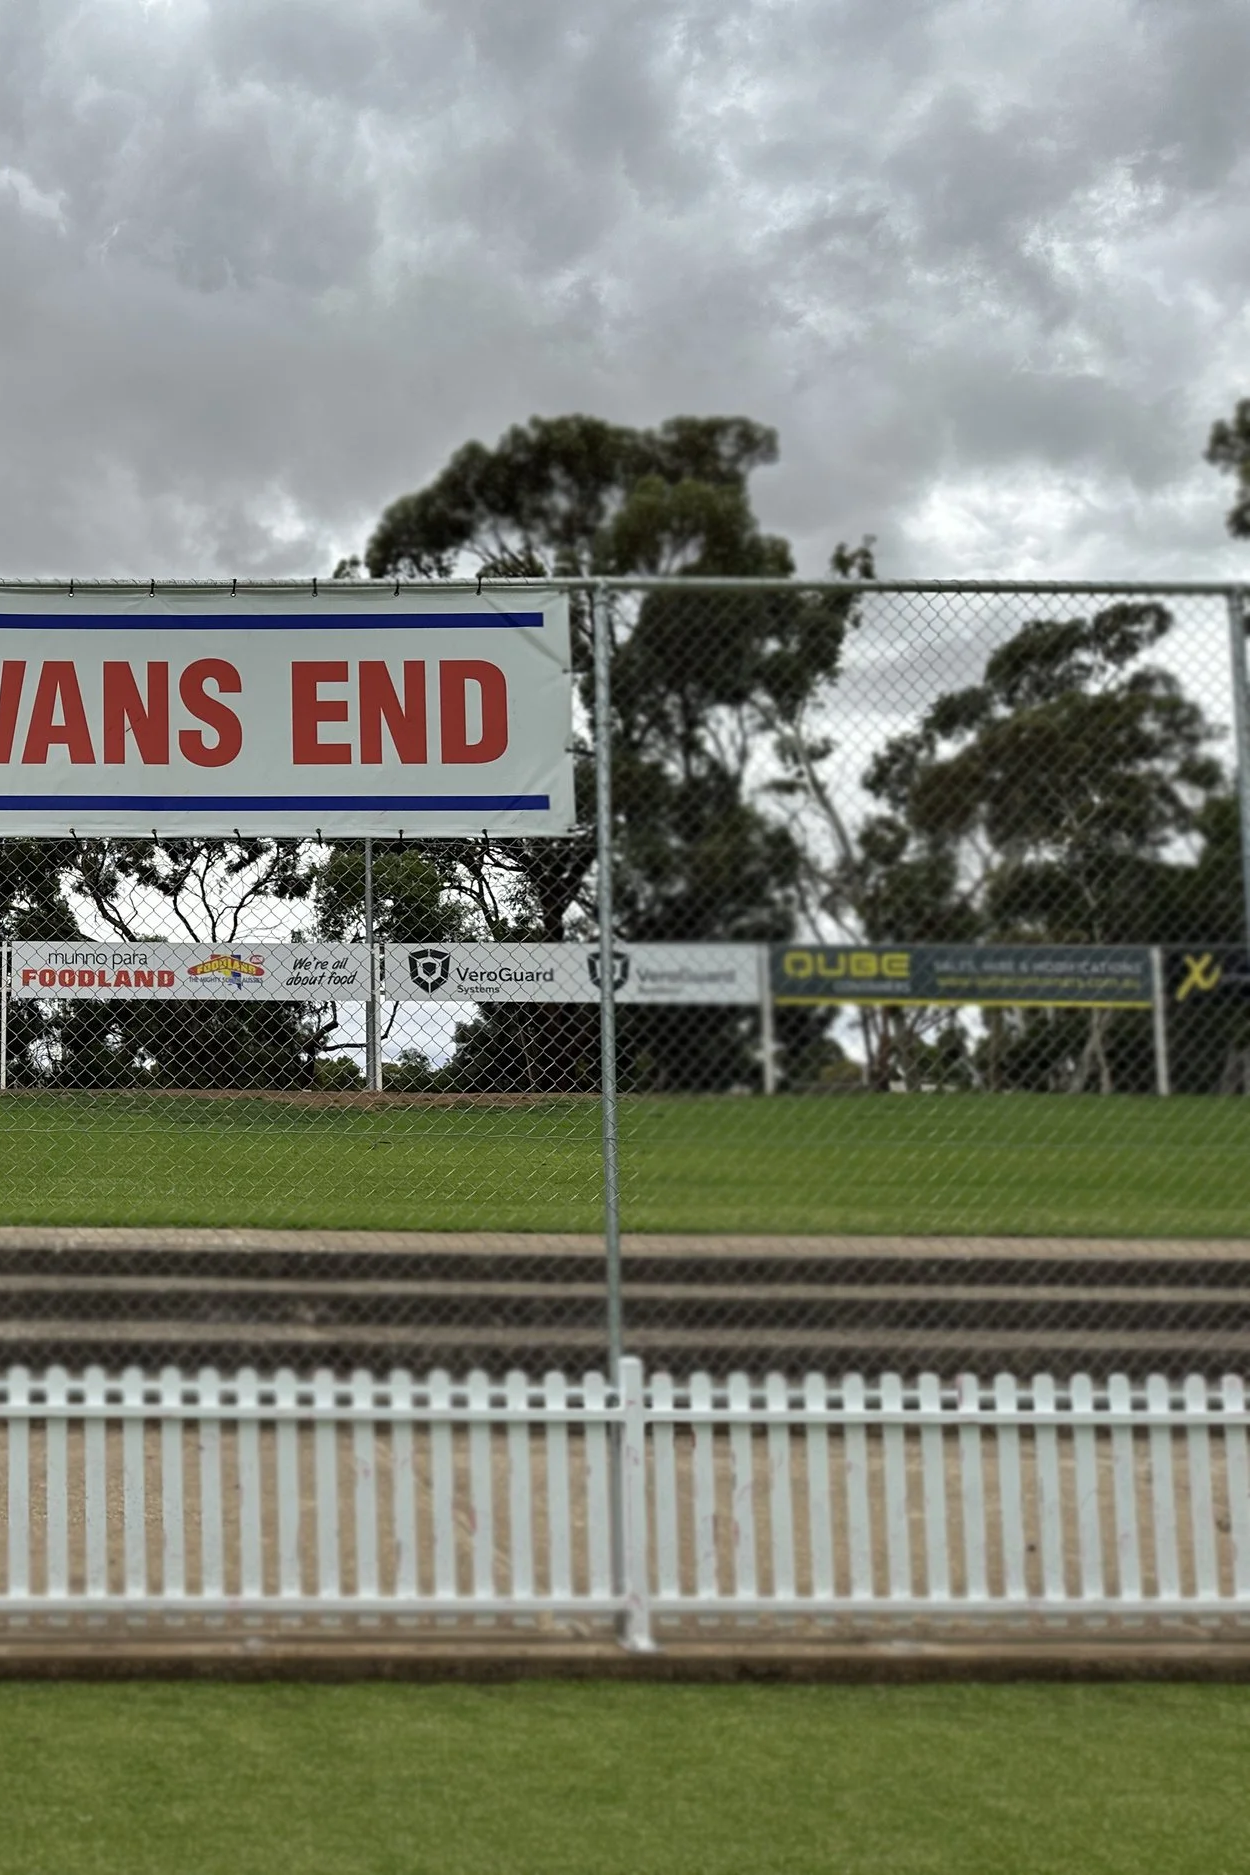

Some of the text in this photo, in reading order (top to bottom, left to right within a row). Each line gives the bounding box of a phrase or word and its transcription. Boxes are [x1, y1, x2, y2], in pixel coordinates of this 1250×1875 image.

[292, 660, 509, 766] END
[48, 952, 148, 969] munno para
[293, 957, 348, 971] We're all
[22, 969, 175, 987] FOODLAND
[286, 971, 357, 986] about food
[456, 967, 555, 982] VeroGuard
[457, 984, 500, 995] Systems
